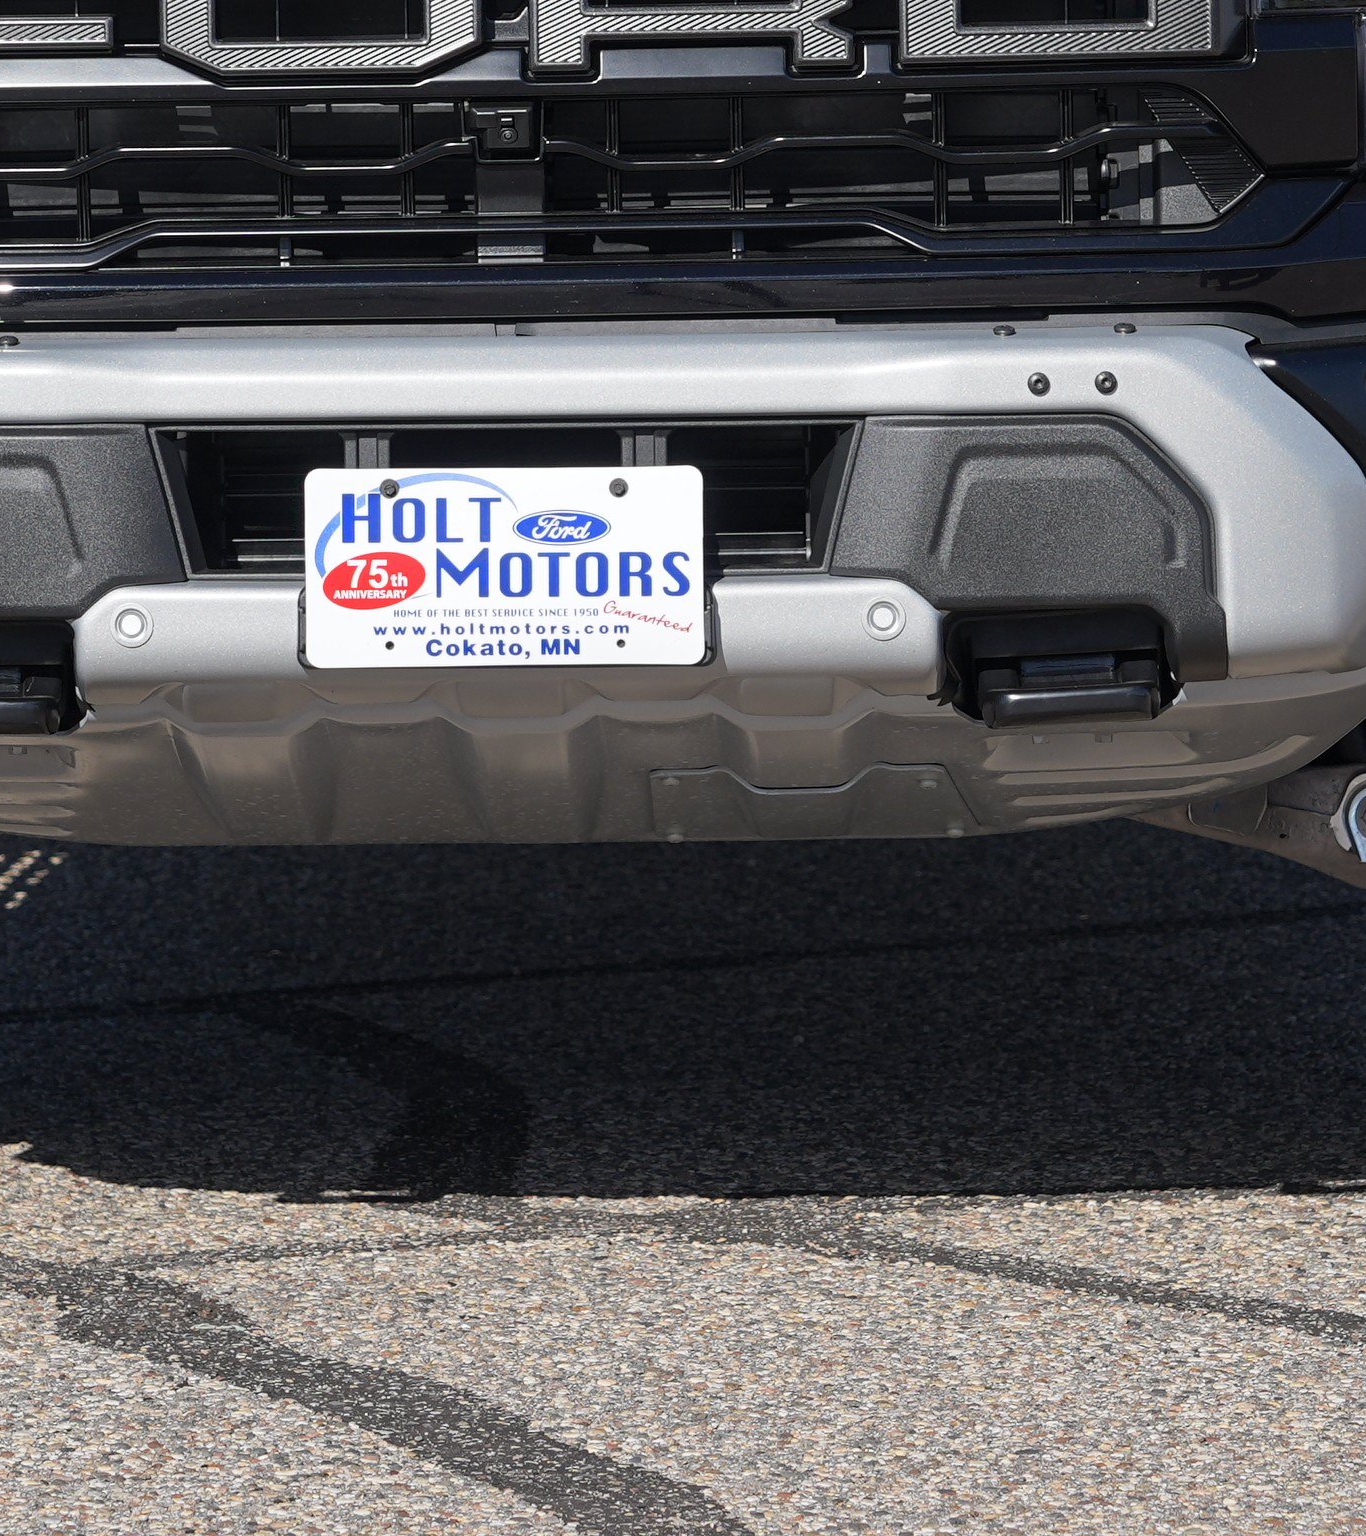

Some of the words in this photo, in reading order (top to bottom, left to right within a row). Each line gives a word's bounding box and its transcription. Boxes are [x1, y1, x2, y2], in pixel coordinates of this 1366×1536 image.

[341, 493, 502, 544] HOLT
[530, 513, 593, 541] Ford
[346, 559, 409, 590] 75th
[435, 547, 691, 598] MOTORS
[333, 589, 408, 600] ANNIVERSARY
[393, 609, 423, 618] HOME
[427, 609, 437, 618] OF
[443, 609, 461, 618] THE
[464, 609, 488, 618] BEST
[492, 608, 535, 617] SERVICE
[538, 608, 569, 617] SINCE
[573, 608, 599, 617] 1950
[603, 600, 693, 633] Guaranteed
[373, 622, 630, 636] www.holtmotors.com
[425, 638, 531, 660] Cokato,
[540, 638, 581, 655] MN
